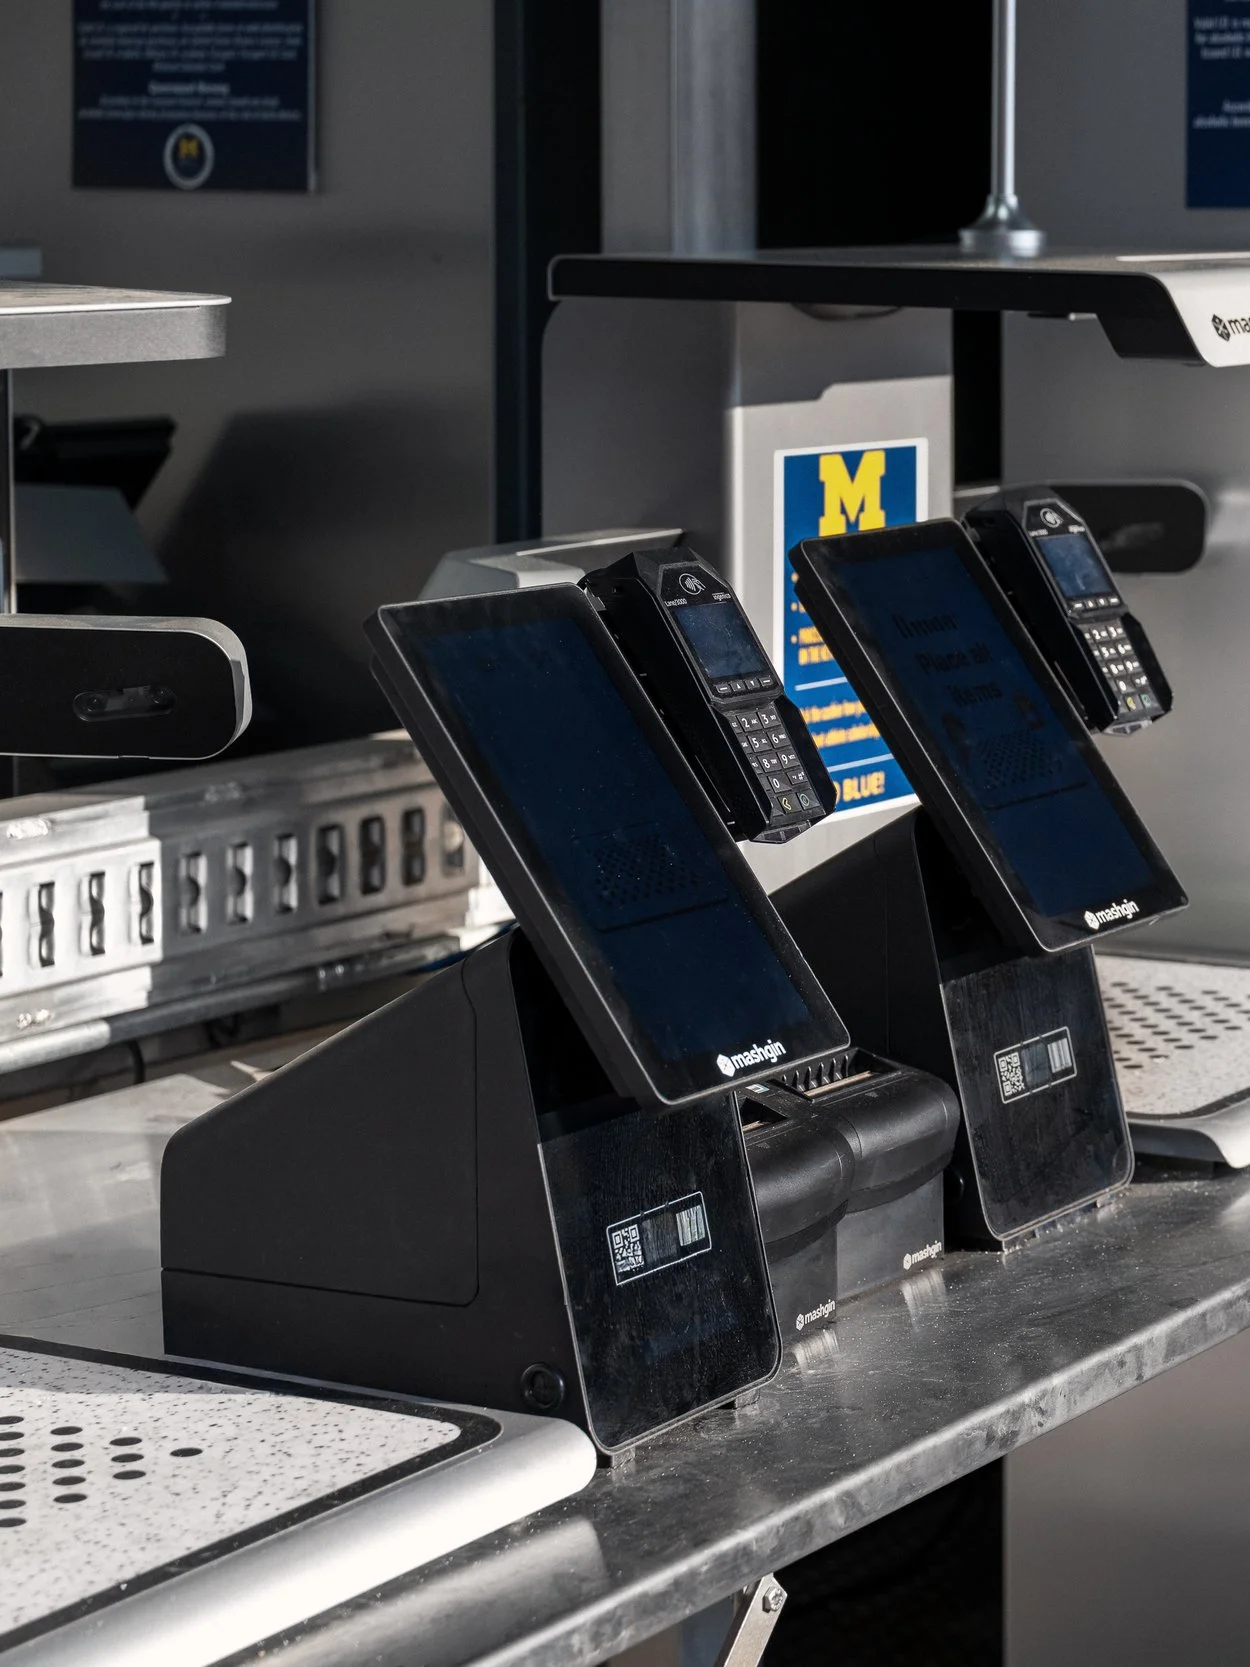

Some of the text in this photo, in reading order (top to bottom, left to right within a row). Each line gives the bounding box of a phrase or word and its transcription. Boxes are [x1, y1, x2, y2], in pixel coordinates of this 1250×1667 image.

[819, 450, 886, 537] M
[742, 718, 750, 728] 2
[761, 714, 769, 724] 3
[752, 737, 759, 748] 5
[772, 734, 779, 744] 6
[762, 758, 770, 768] 8
[781, 754, 788, 764] 9
[772, 778, 780, 788] 0
[842, 771, 885, 802] BLUE!
[1095, 899, 1140, 923] mashgin
[730, 1039, 786, 1070] mashgin
[911, 1240, 942, 1264] mashgin
[804, 1299, 836, 1325] mashgin
